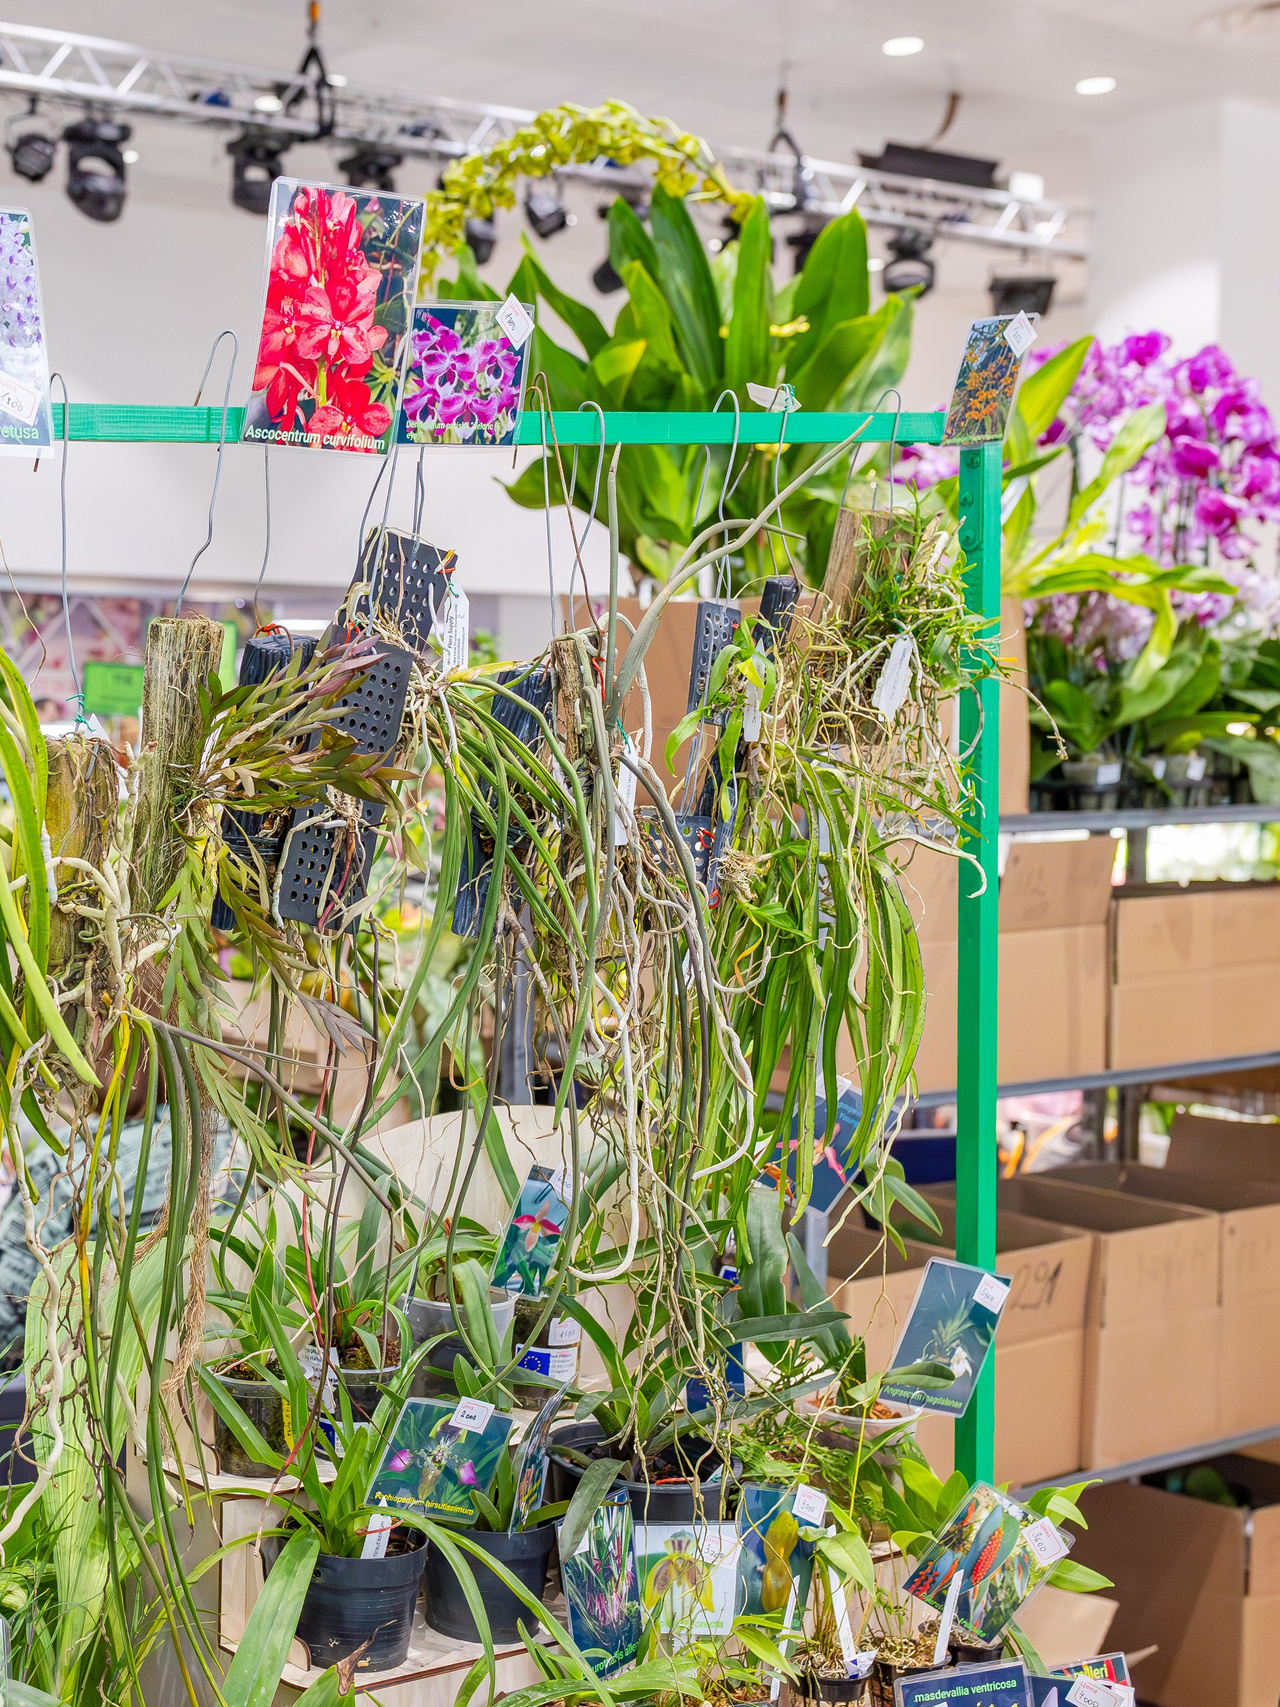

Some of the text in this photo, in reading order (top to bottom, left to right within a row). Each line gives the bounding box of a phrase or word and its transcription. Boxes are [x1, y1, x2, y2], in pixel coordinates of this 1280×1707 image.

[245, 424, 385, 450] Ascocentrum curvifolium
[460, 1410, 477, 1421] 2000
[971, 1679, 1017, 1694] ventricosa
